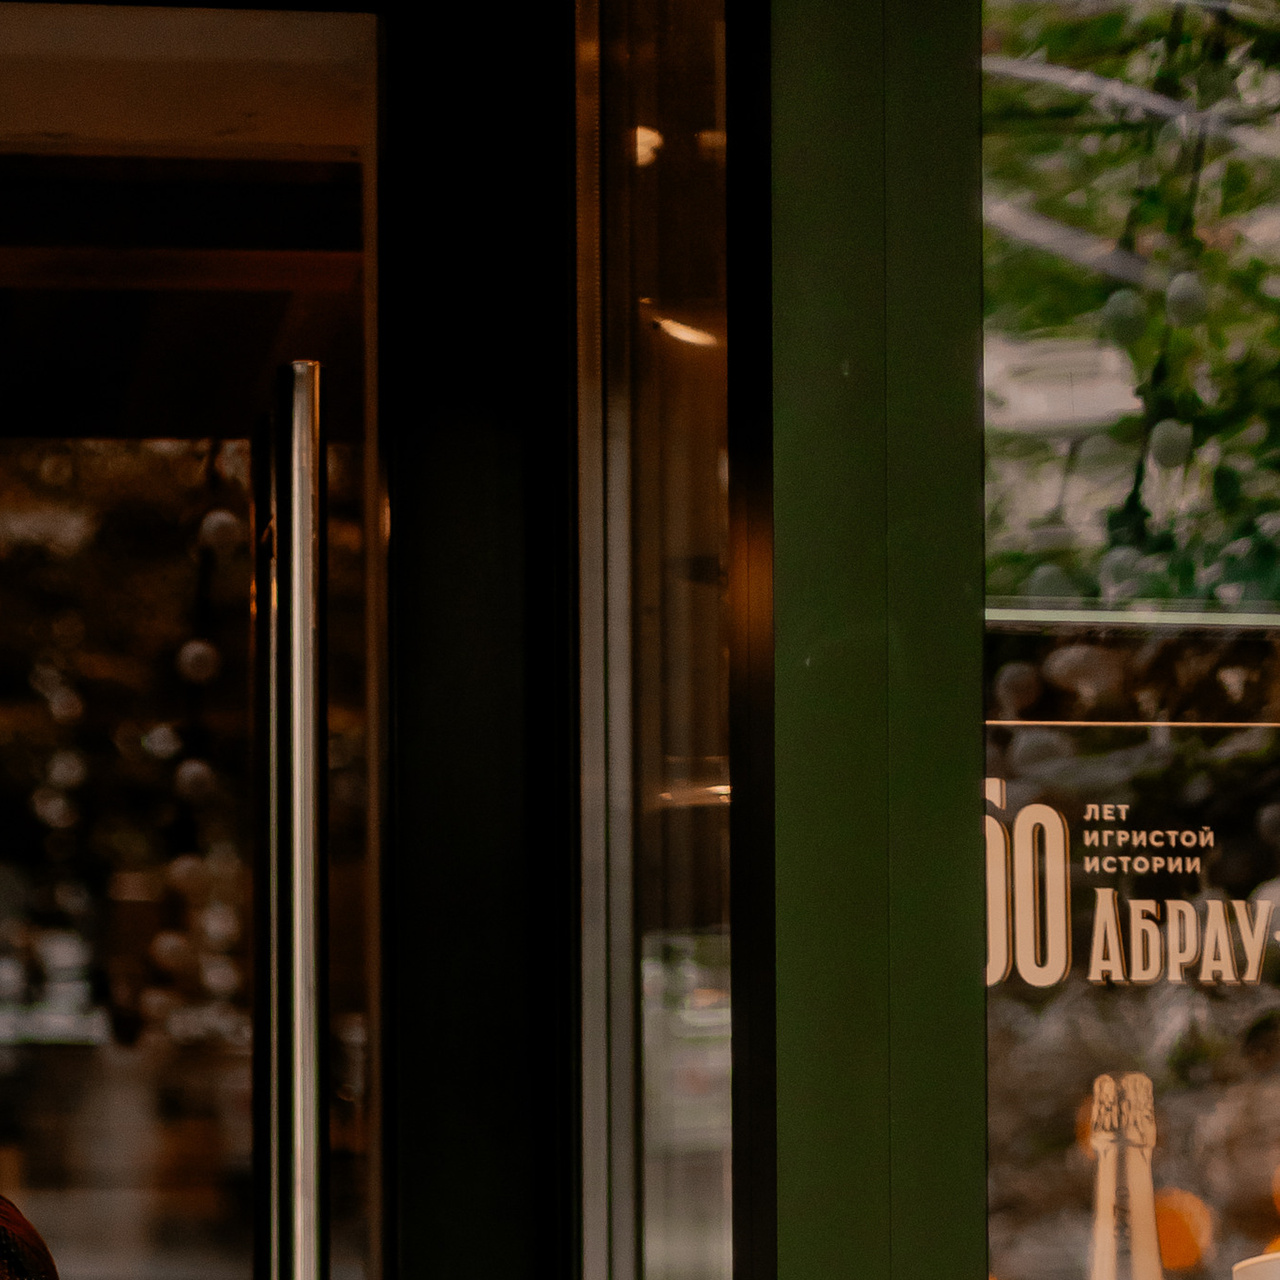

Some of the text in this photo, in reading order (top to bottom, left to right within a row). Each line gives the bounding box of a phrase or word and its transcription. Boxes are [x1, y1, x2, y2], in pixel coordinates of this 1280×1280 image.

[1083, 803, 1130, 822] ЛЕТ
[1083, 826, 1215, 848] ИГРИСТОЙ
[1083, 855, 1202, 875] ИСТОРИИ
